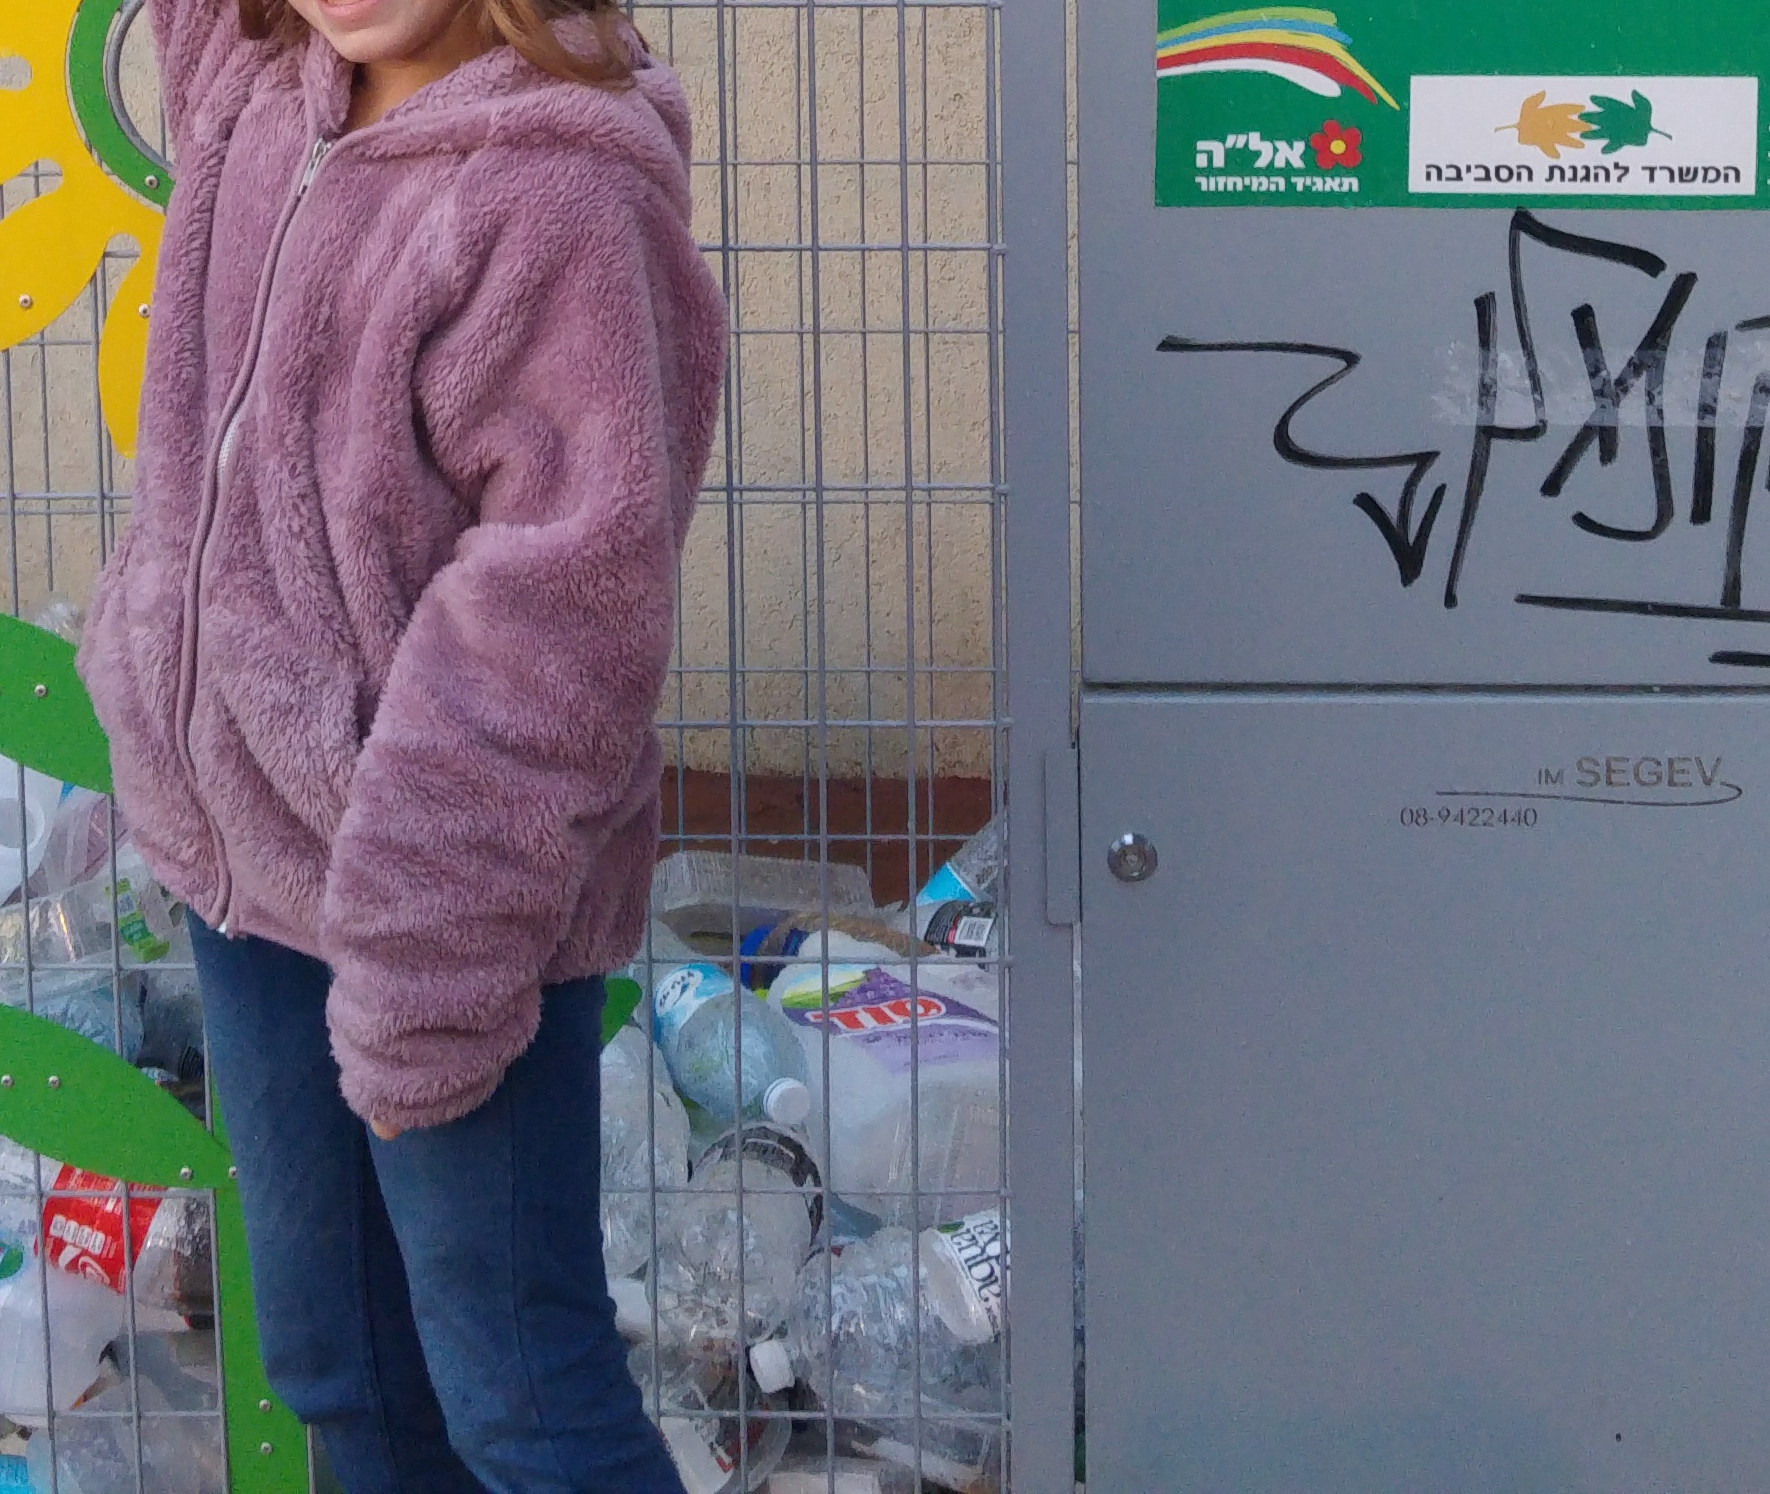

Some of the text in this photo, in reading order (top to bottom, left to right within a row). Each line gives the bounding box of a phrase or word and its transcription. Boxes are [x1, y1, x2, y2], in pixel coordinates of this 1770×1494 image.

[1425, 162, 1742, 184] המשרד להגנת הסביבה
[1195, 176, 1360, 193] תאגיד המיחזור
[1576, 755, 1723, 789] SEGEV
[1399, 806, 1538, 828] 08-9422440
